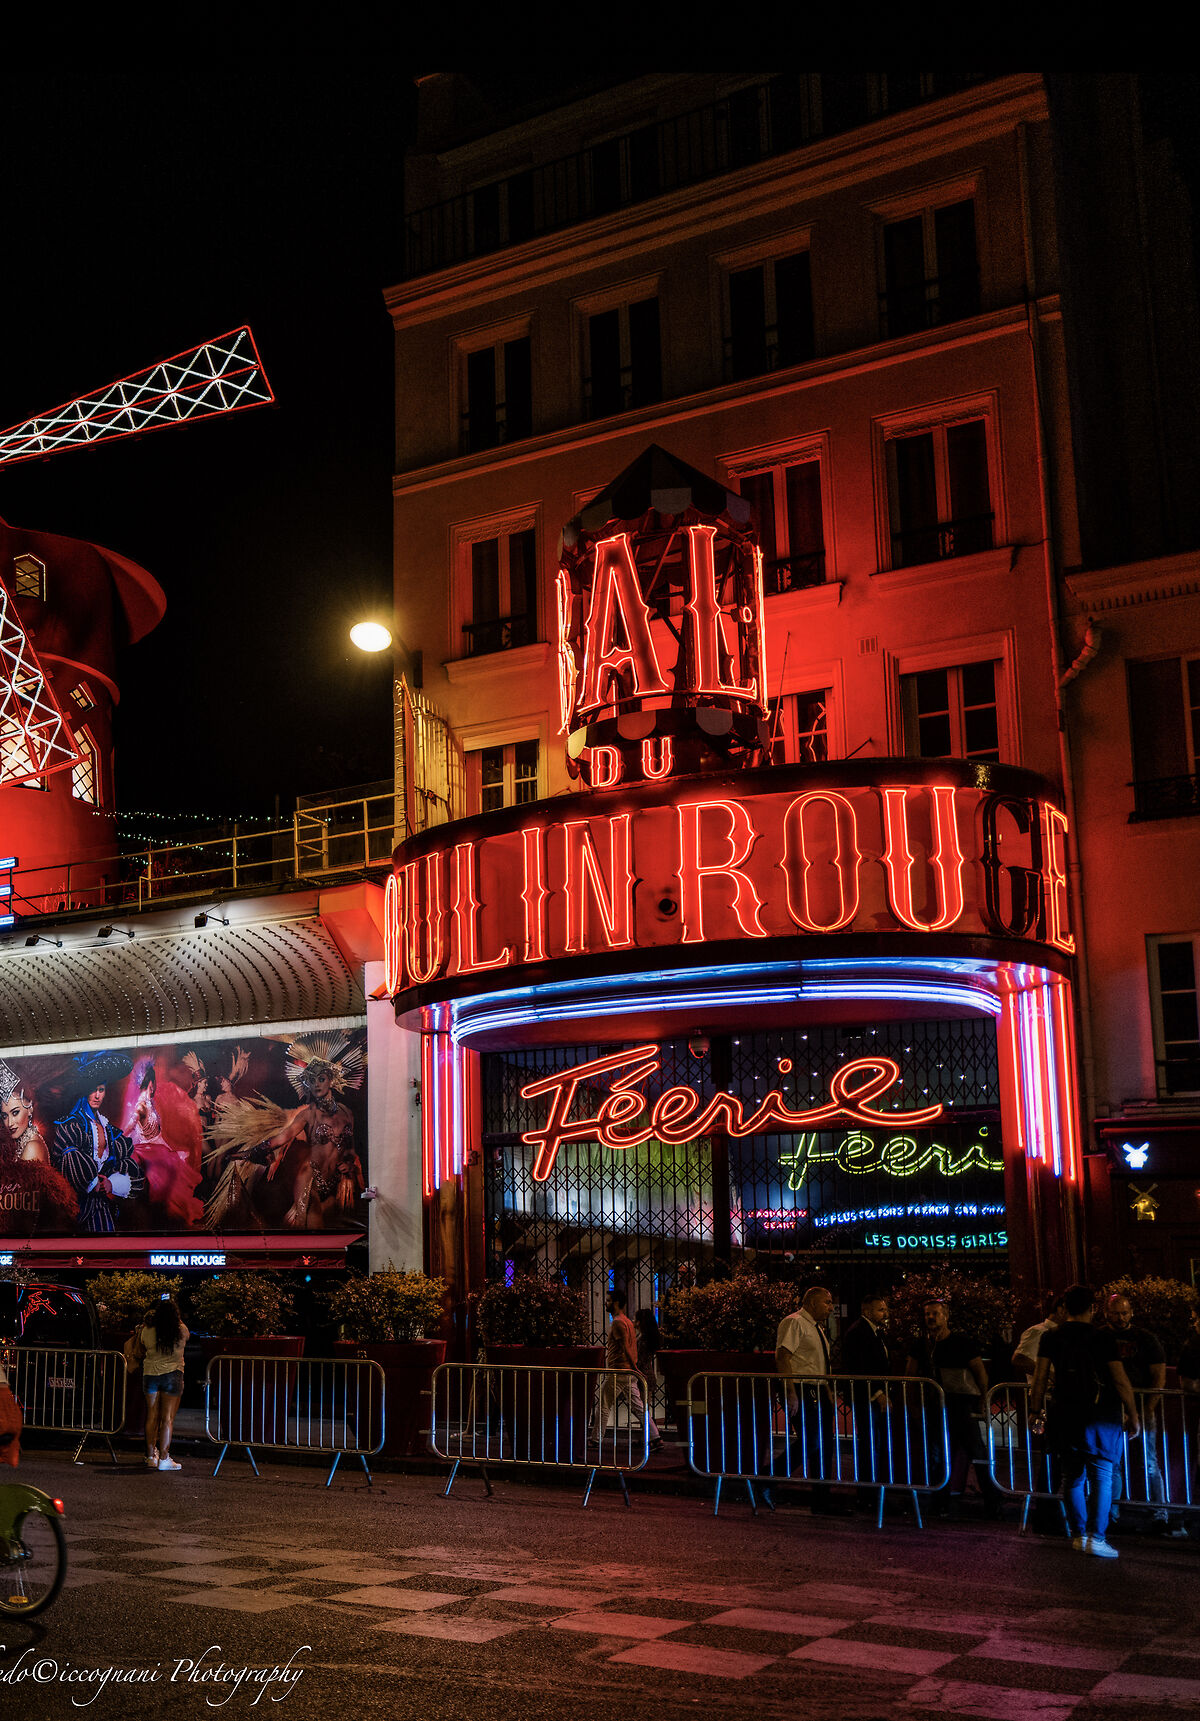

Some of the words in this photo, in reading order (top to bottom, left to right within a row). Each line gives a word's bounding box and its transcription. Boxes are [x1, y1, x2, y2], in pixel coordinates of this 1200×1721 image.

[590, 737, 674, 787] DU
[384, 812, 637, 996] OULIN
[677, 785, 1076, 955] ROUGE
[521, 1045, 943, 1182] Féerie
[778, 1125, 1005, 1191] Féeri
[830, 1211, 858, 1226] PLUS
[865, 1231, 892, 1247] LES
[961, 1231, 1009, 1247] GIRLS
[150, 1255, 189, 1267] MOULIN
[190, 1254, 226, 1266] ROUGE
